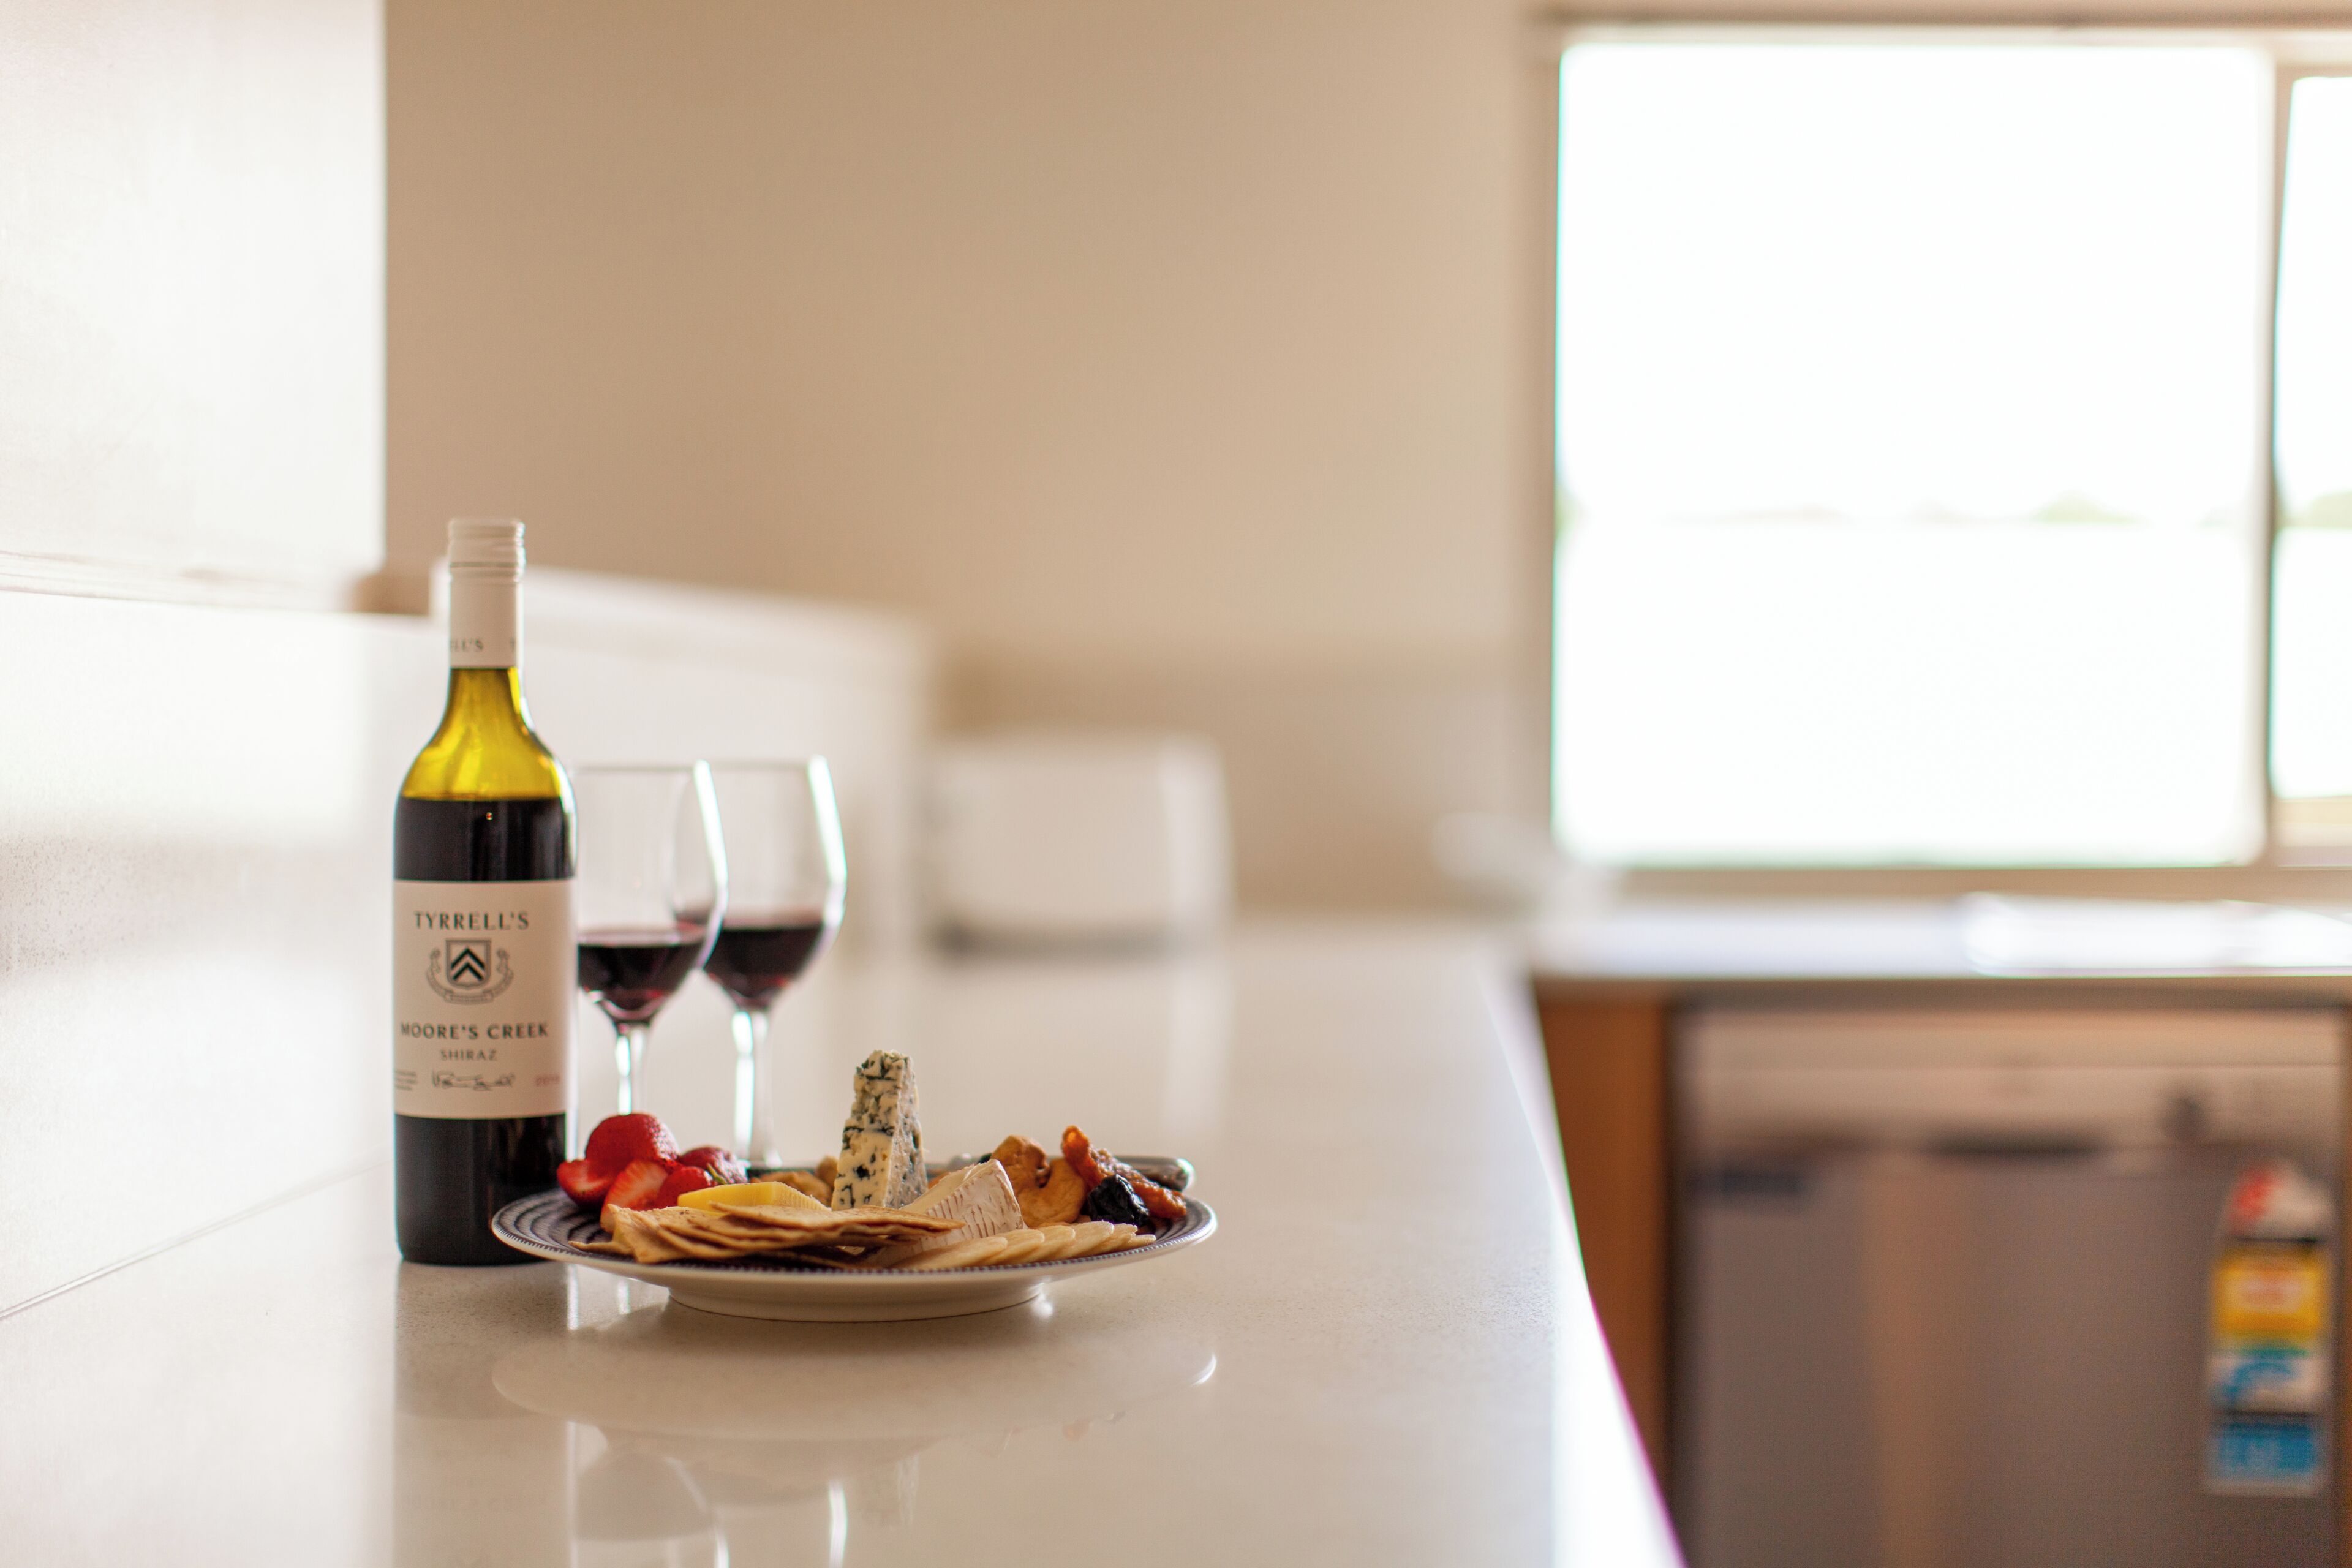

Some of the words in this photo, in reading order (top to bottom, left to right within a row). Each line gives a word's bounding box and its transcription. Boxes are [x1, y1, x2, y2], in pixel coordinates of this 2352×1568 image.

[414, 911, 529, 930] TYRRELL'S
[401, 1021, 479, 1040] MOORE'S
[487, 1022, 549, 1040] CREEK
[440, 1047, 498, 1062] SHIRAZ
